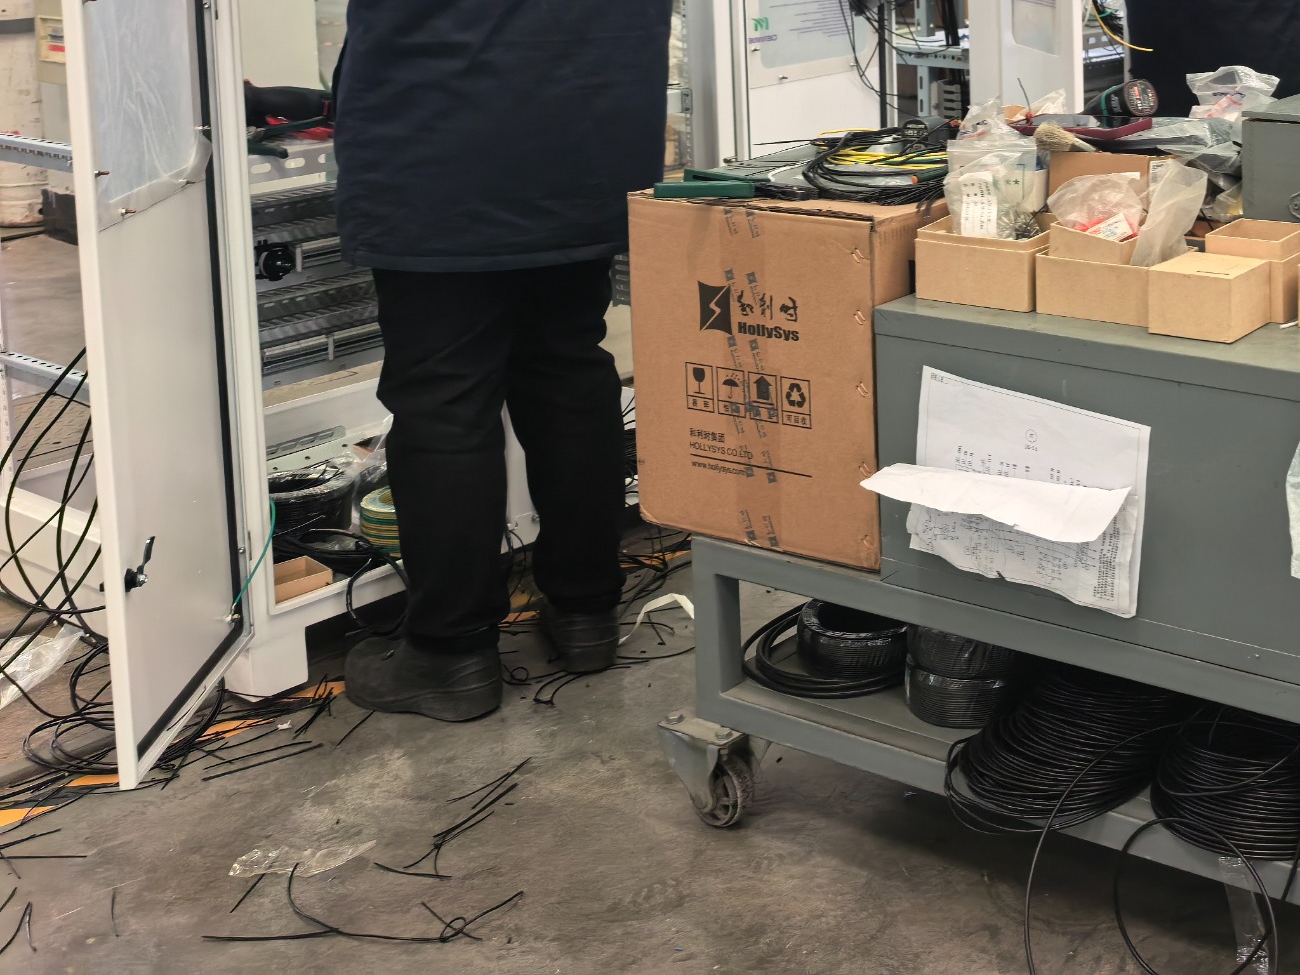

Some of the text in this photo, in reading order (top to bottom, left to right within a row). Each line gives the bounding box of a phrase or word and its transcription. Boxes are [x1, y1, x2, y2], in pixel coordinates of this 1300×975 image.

[737, 321, 800, 342] HollySys
[785, 413, 808, 426] 可回收
[689, 441, 727, 455] HOLLYSYS
